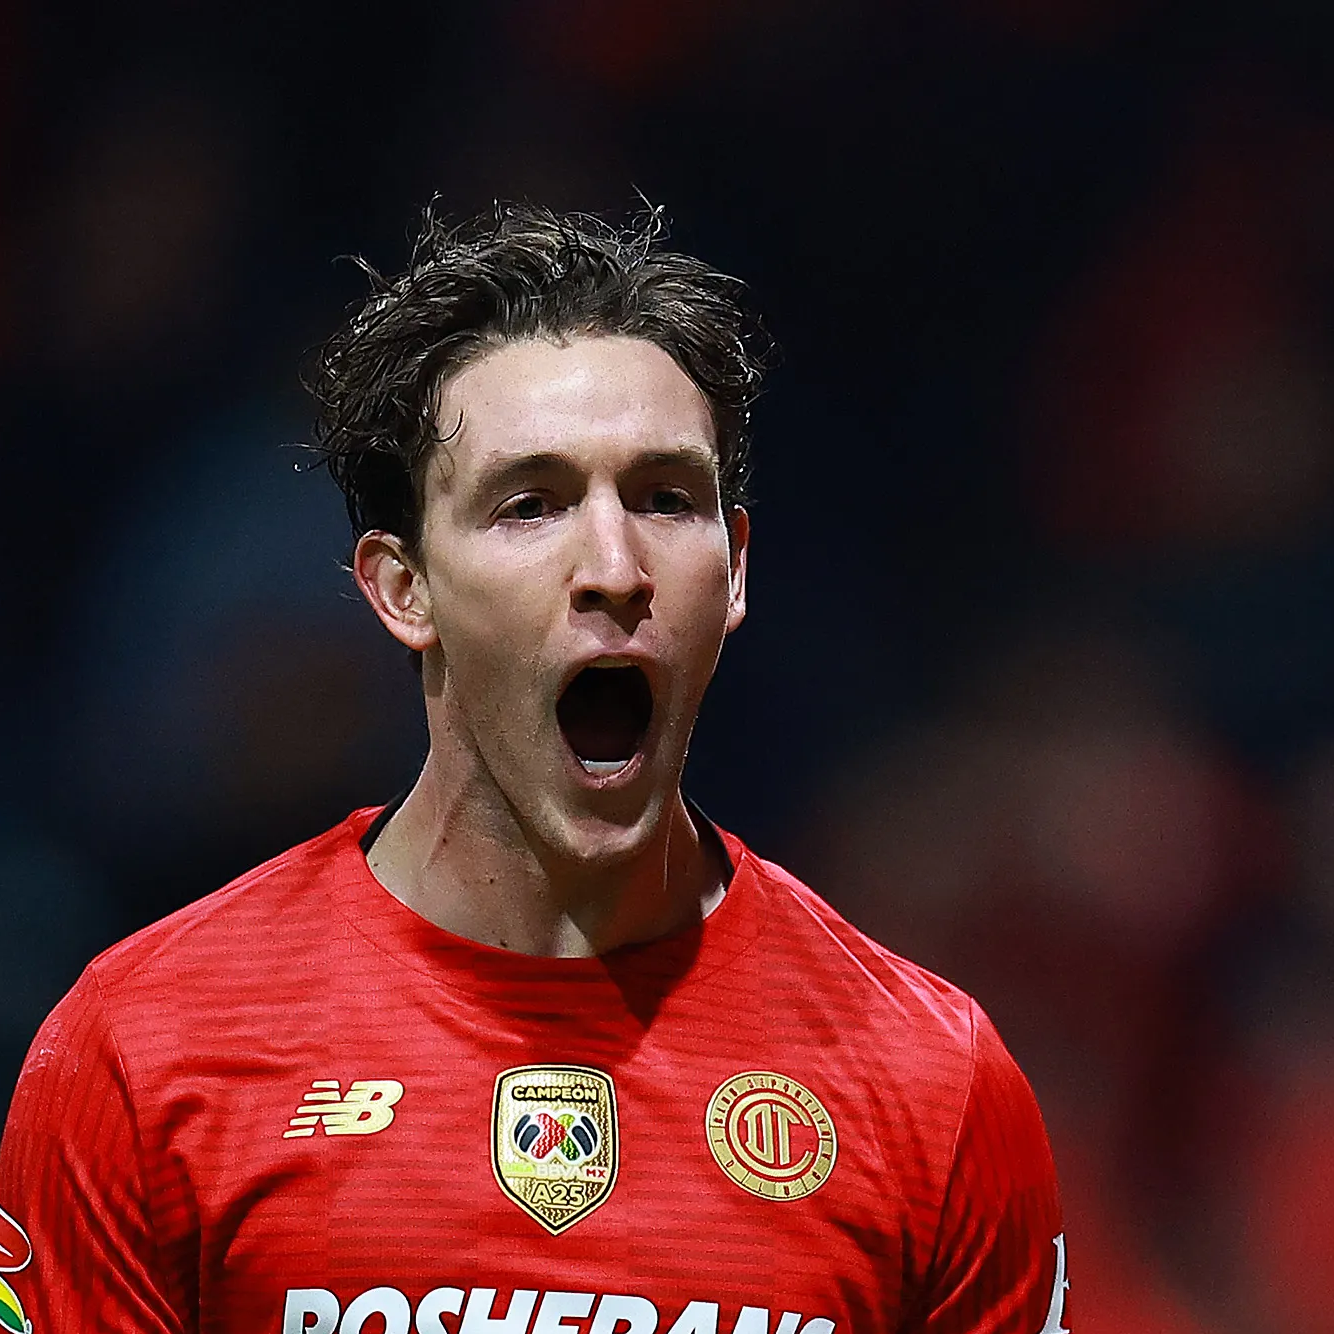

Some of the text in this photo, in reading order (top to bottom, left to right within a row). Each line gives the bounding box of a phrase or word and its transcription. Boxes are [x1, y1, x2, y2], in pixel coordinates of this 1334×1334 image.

[513, 1085, 598, 1101] CAMPEÓN
[283, 1080, 404, 1138] NB
[586, 1168, 606, 1178] MX
[530, 1182, 586, 1208] A25
